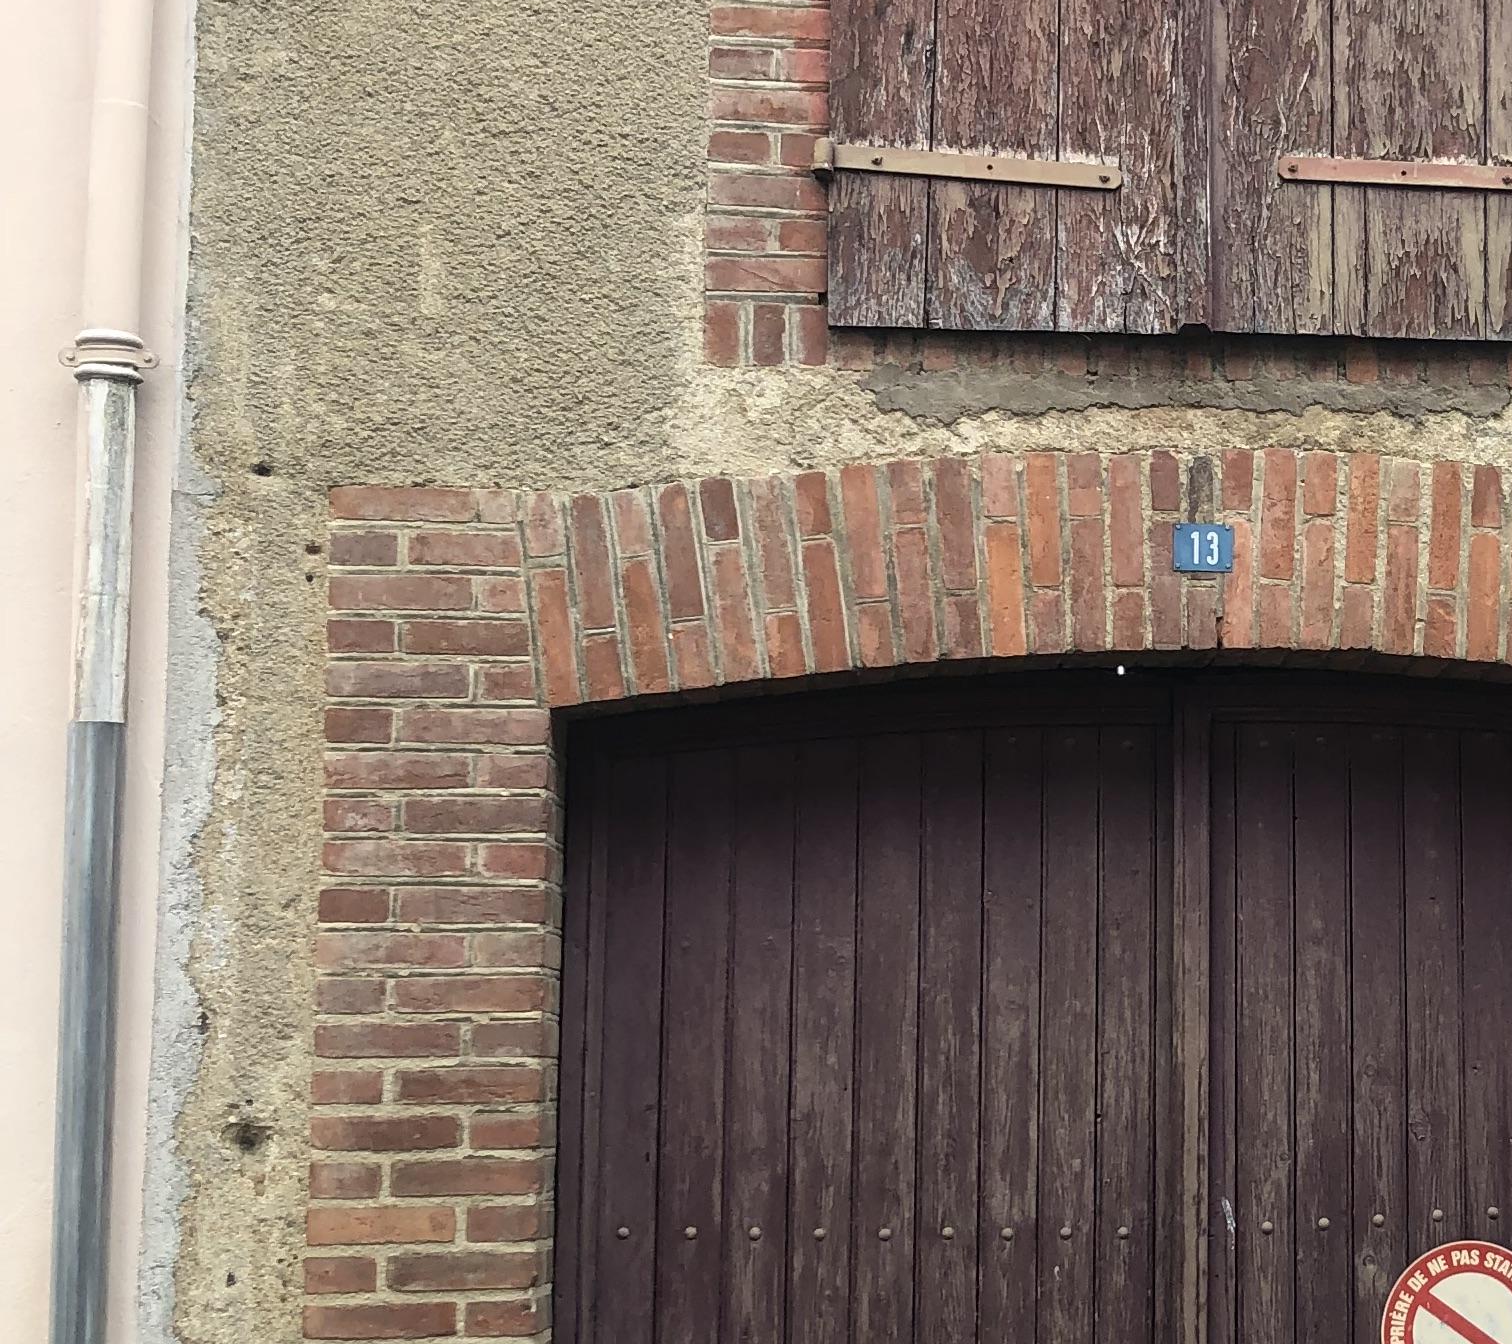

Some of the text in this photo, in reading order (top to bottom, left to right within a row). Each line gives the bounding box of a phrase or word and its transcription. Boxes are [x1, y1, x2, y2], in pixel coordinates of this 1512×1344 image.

[1190, 531, 1219, 565] 13
[1407, 1270, 1428, 1293] DE
[1426, 1255, 1449, 1276] NE
[1451, 1249, 1480, 1266] PAS
